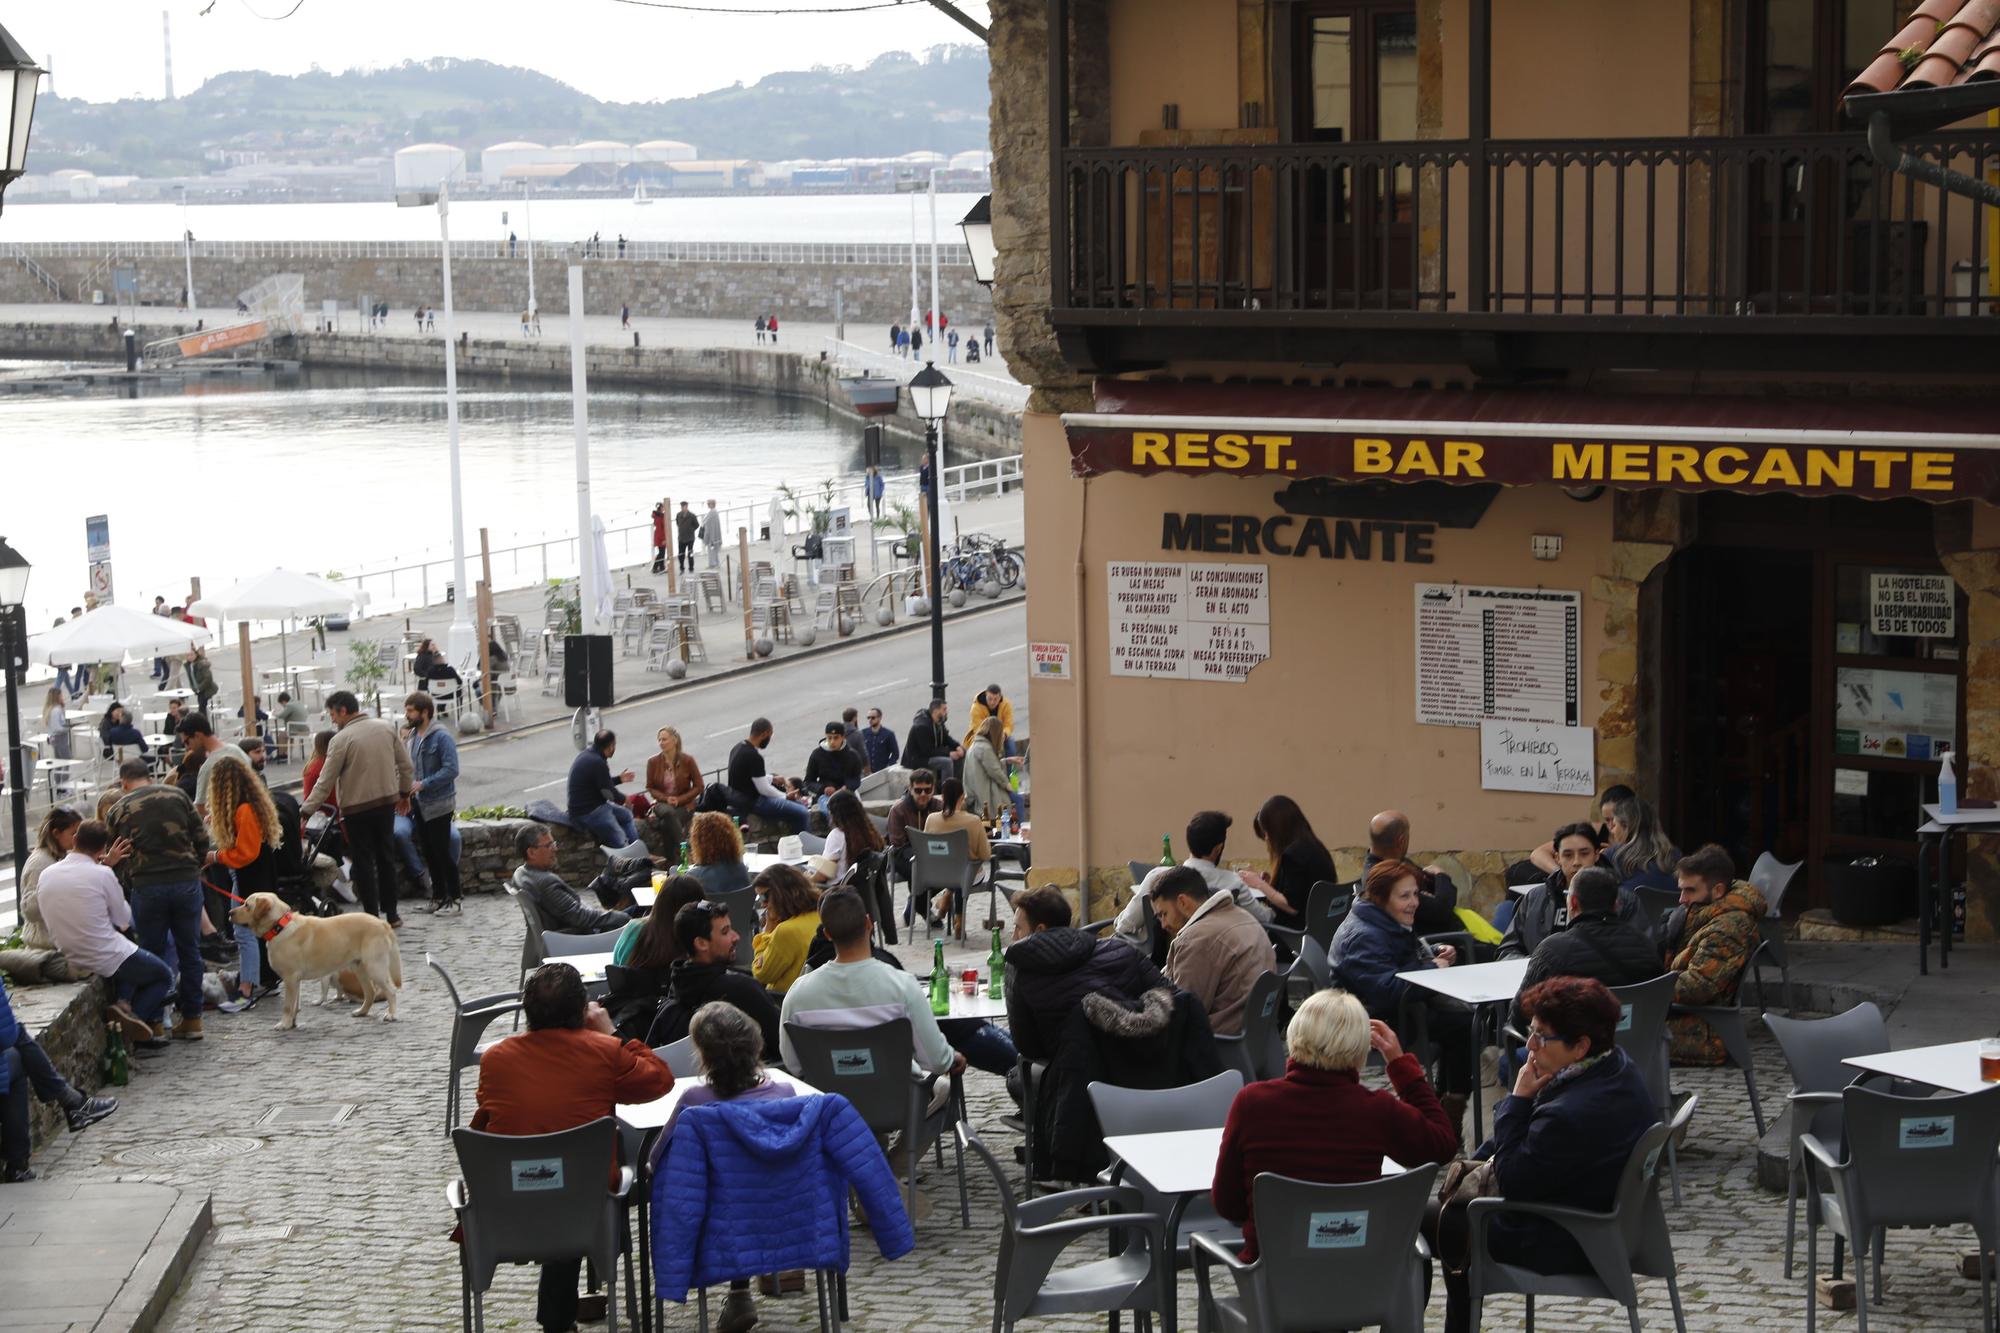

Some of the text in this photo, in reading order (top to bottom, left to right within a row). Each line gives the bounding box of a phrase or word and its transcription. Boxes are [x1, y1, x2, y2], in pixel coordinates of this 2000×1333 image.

[1132, 431, 1955, 491] REST. BAR MERCANTE
[1161, 512, 1436, 564] MERCANTE
[1112, 566, 1182, 578] SE RUEGA NO MUEVAN
[1190, 570, 1264, 584] LAS CONSUMICIONES
[1129, 578, 1165, 590] LAS MESAS
[1878, 577, 1946, 590] LA HOSTELERIA
[1118, 592, 1178, 604] PREGUNTAR ANTES
[1221, 586, 1259, 600] ABONADAS
[1467, 588, 1577, 602] RACIONES
[1878, 590, 1949, 606] NO ES EL VIRUS,
[1125, 604, 1171, 615] AL CAMARERO
[1206, 602, 1249, 616] EN EL ACTO
[1874, 604, 1952, 620] LA RESPONSABILIDAD
[1121, 622, 1179, 636] EL PERSONAL DE
[1212, 626, 1222, 637] DE
[1233, 627, 1239, 638] A
[1878, 619, 1947, 634] ES DE TODOS
[1131, 635, 1169, 647] ESTA CASA
[1209, 638, 1214, 649] Y
[1215, 638, 1225, 650] DE
[1234, 639, 1239, 650] A
[1115, 646, 1186, 660] NO ESCANCIA SIDRA
[1193, 650, 1217, 662] MESAS
[1124, 659, 1177, 673] EN LA TERRAZA
[1205, 662, 1223, 675] PARA
[1520, 766, 1534, 778] EN
[1537, 760, 1548, 780] LA
